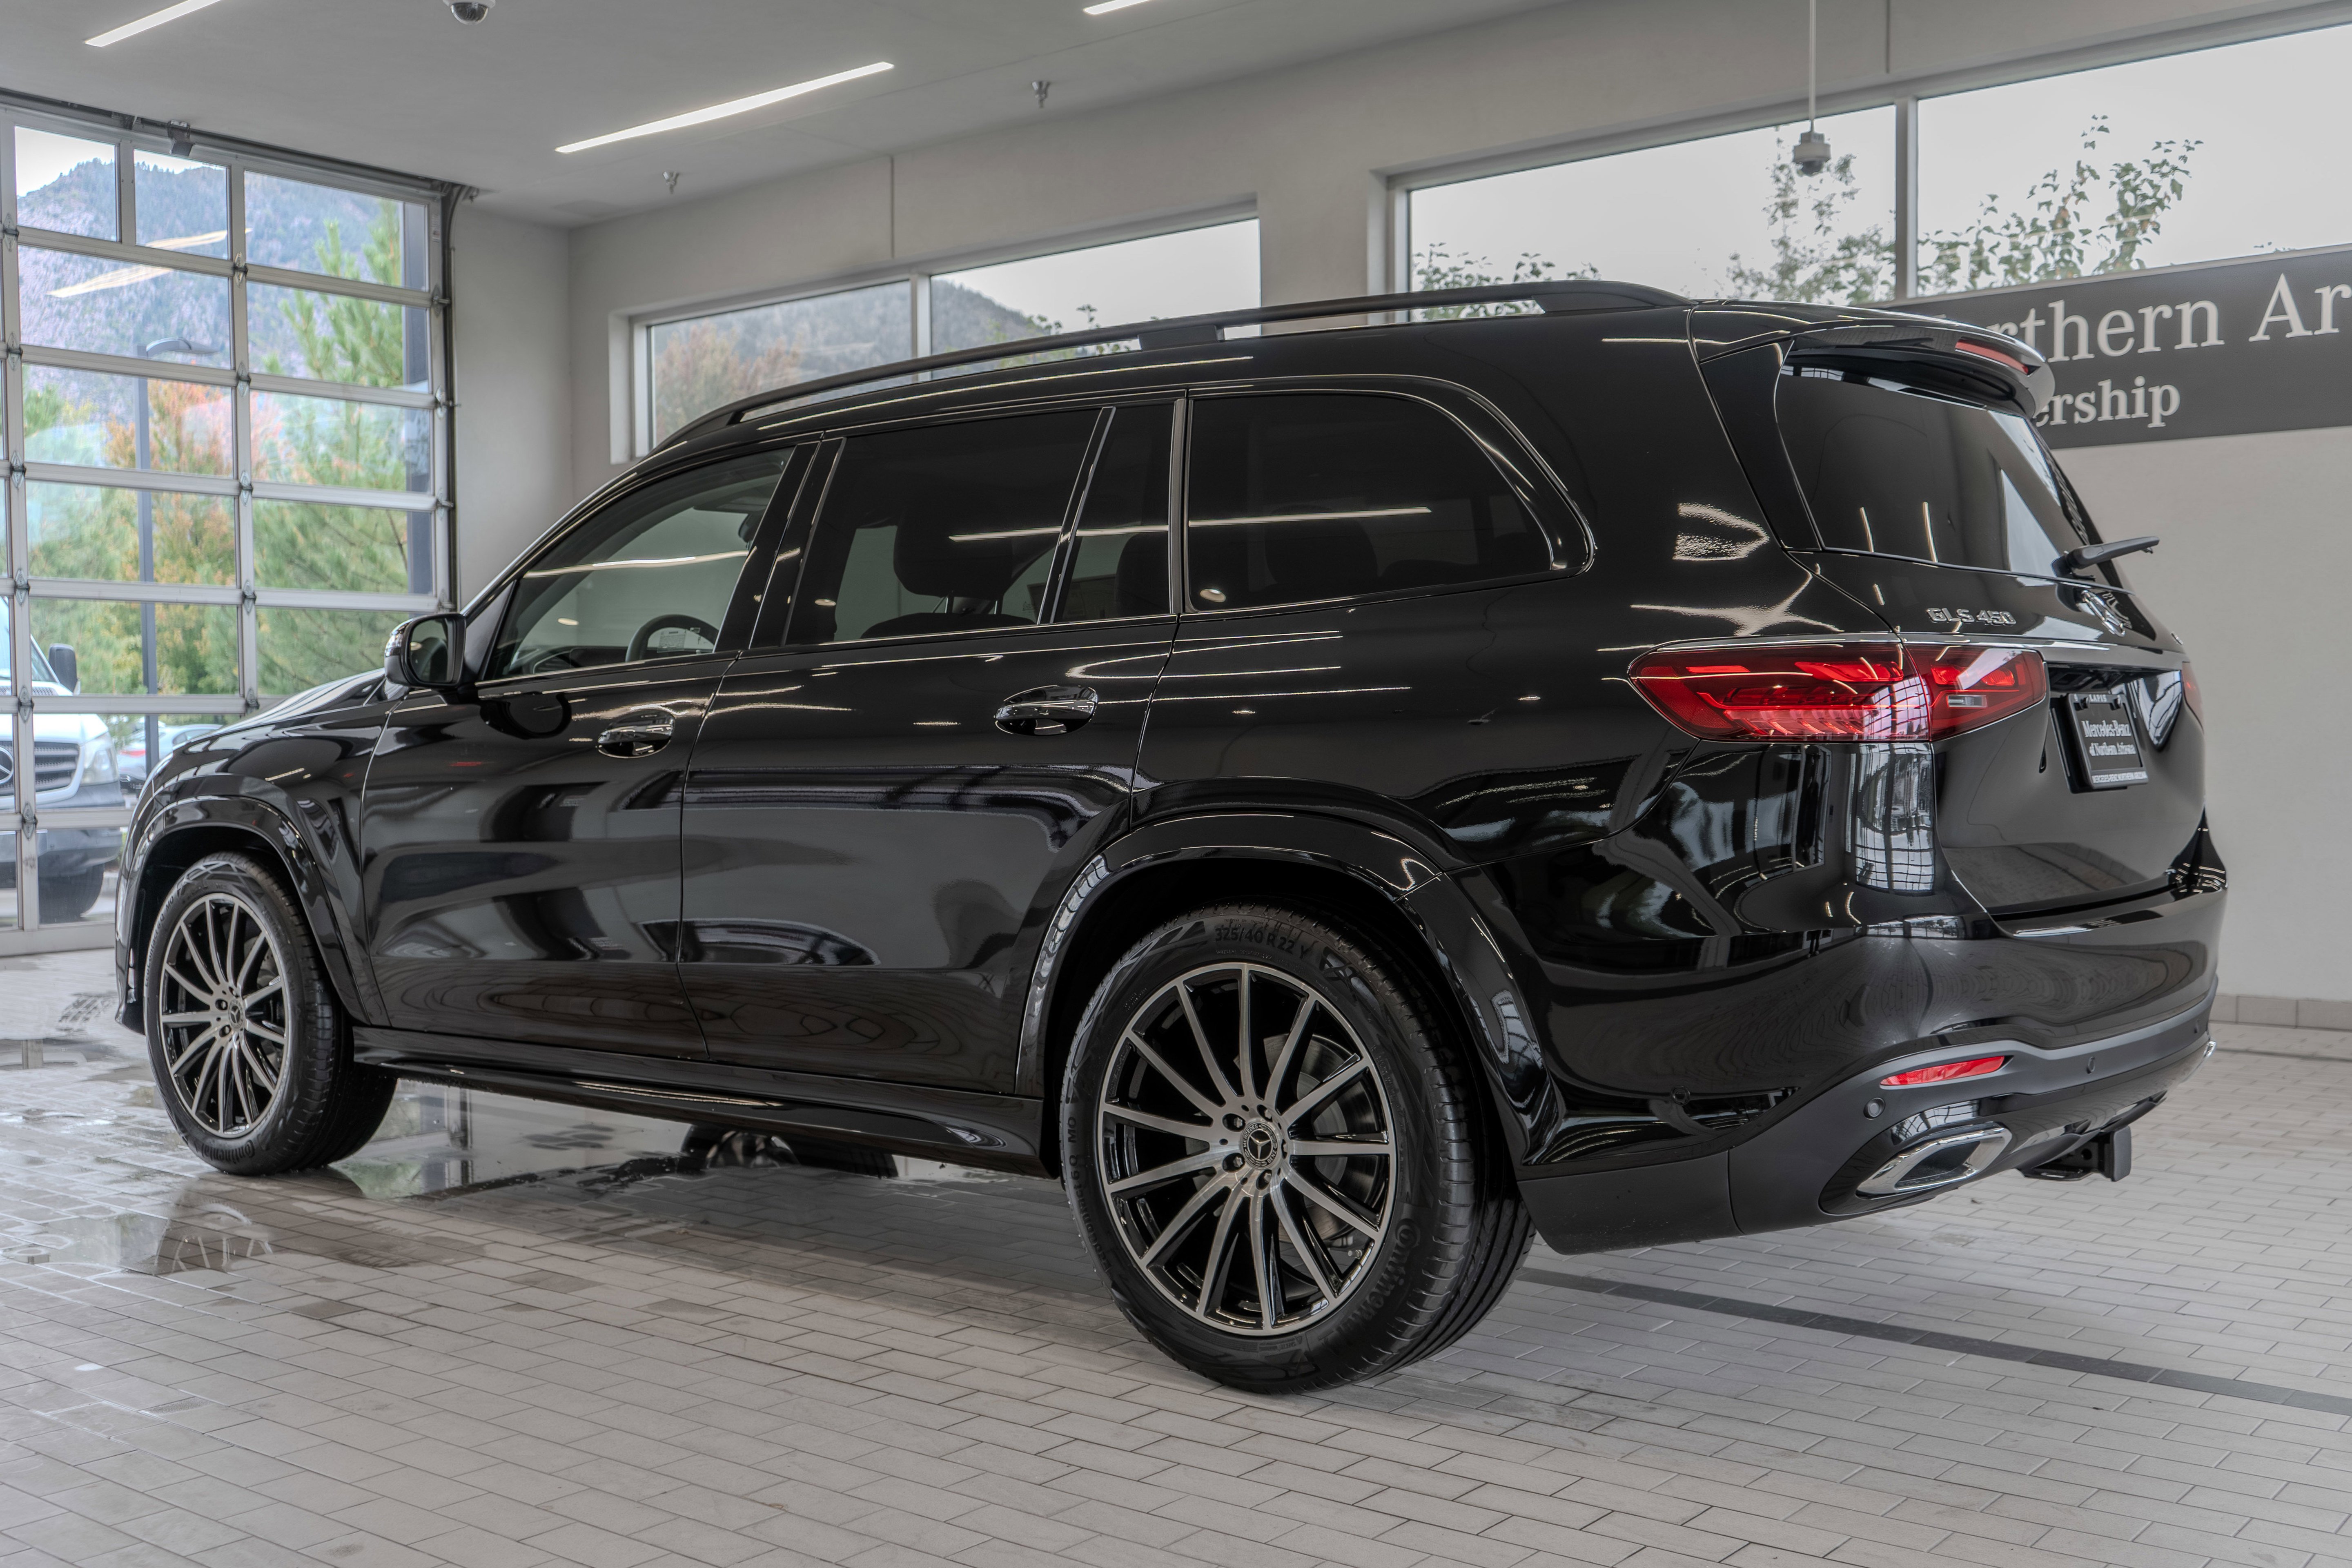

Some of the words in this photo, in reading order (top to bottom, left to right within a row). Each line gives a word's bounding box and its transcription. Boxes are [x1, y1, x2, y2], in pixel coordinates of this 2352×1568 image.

[1926, 608, 1975, 623] GLS
[1976, 610, 2017, 625] 450
[1214, 927, 1263, 944] 325/40
[1067, 1116, 1077, 1143] MO
[1243, 1124, 1258, 1148] MERCEDES
[201, 1139, 255, 1164] Continental
[1267, 1150, 1277, 1164] BENZ
[1334, 1218, 1421, 1344] Continental
